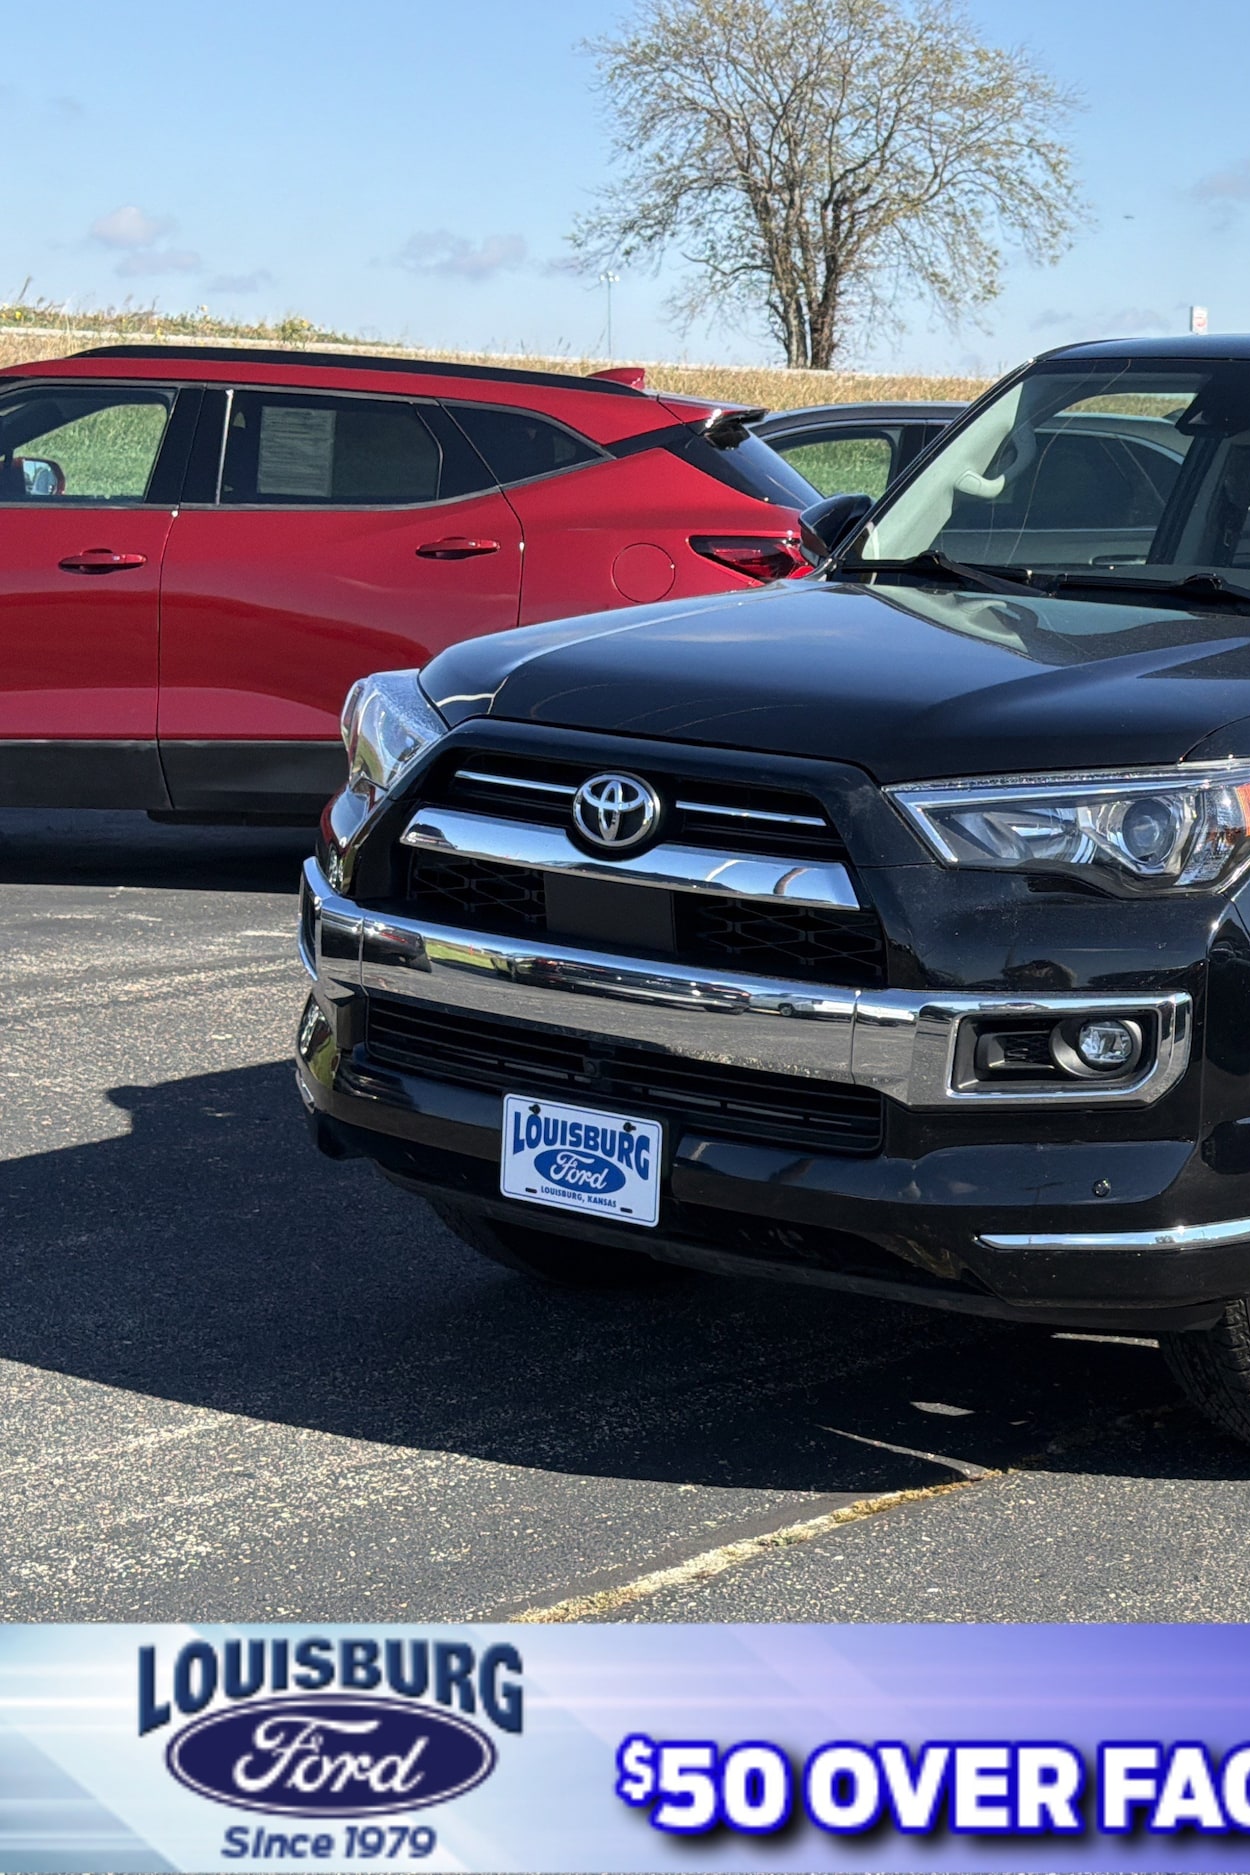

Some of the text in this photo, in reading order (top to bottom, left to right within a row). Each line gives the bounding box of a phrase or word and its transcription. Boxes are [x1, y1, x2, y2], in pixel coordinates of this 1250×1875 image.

[513, 1111, 650, 1181] LOUISBURG
[550, 1151, 609, 1190] Ford
[541, 1185, 617, 1209] LOUISBURG, KANSAS
